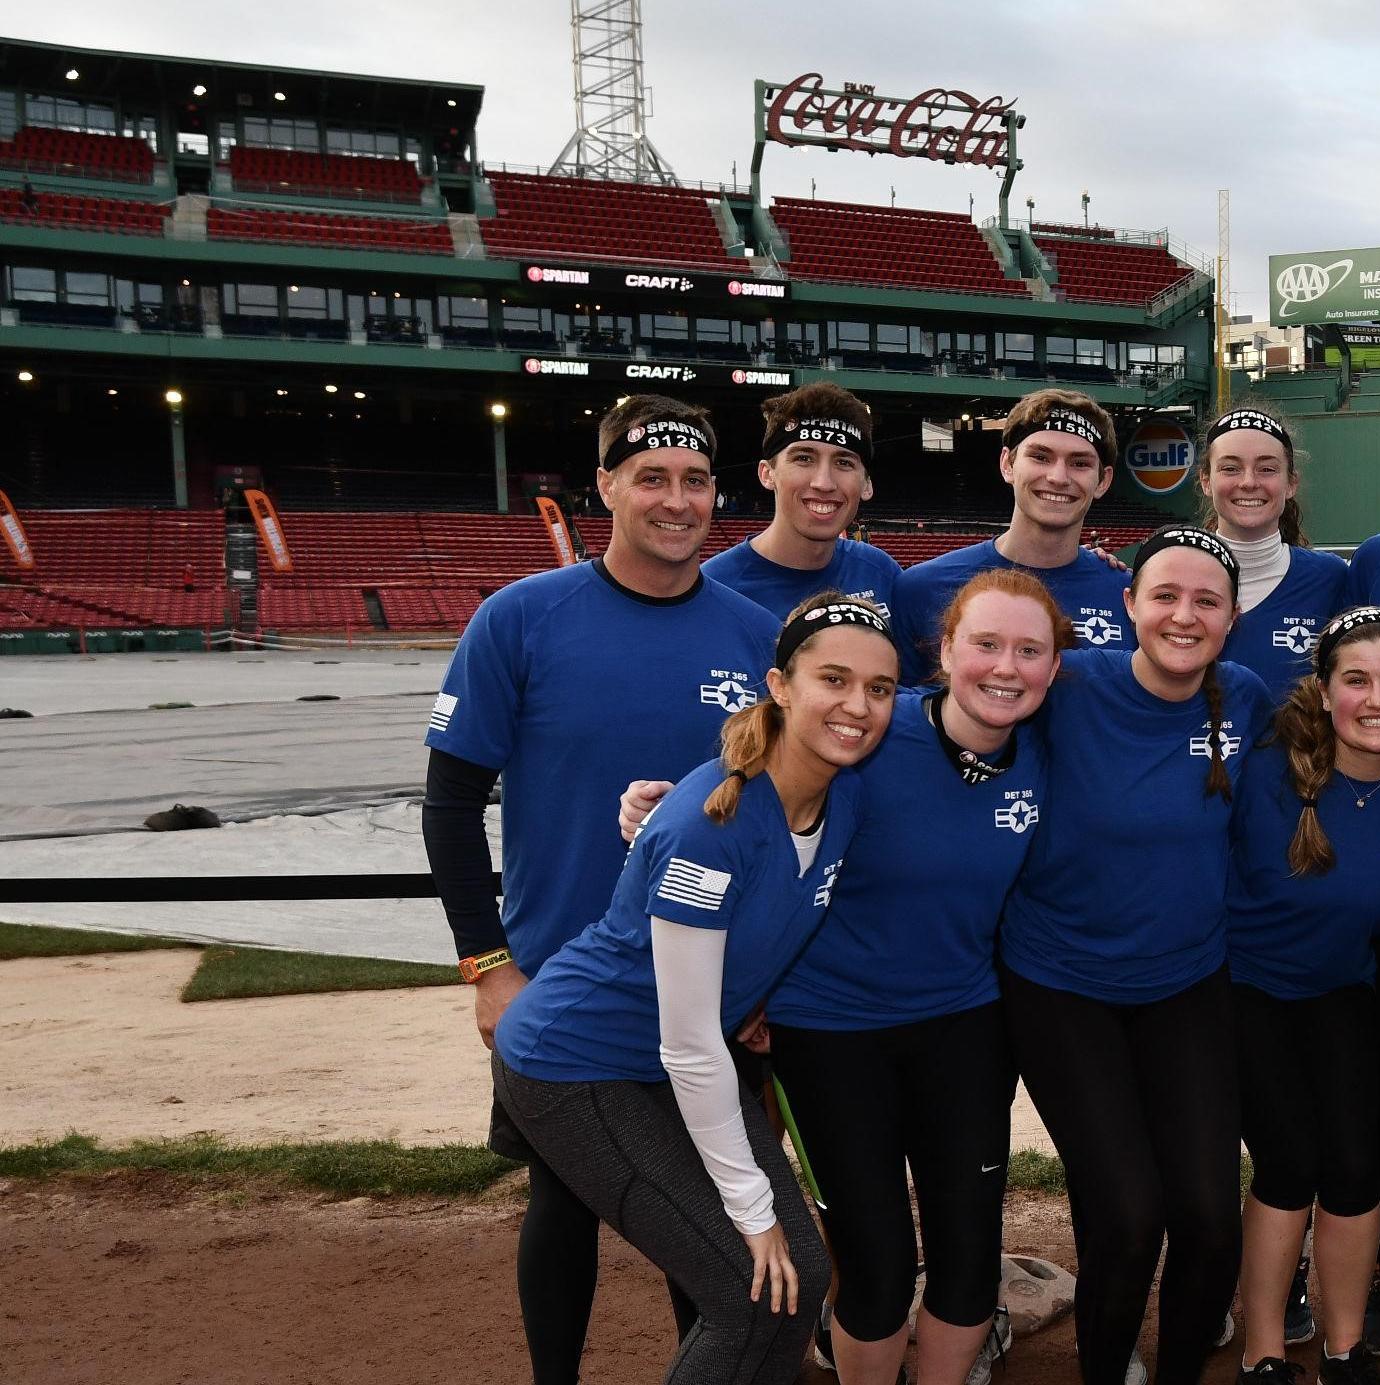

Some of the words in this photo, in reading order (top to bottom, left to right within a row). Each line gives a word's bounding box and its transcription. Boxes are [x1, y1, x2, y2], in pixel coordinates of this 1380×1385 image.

[845, 82, 875, 96] ENJOY
[543, 268, 590, 284] SPARTAN
[625, 274, 679, 290] CRAFT
[1284, 265, 1323, 300] AAA
[741, 283, 785, 298] SPARTAN
[1325, 311, 1343, 319] Auto
[1345, 309, 1380, 318] Insurance
[540, 360, 589, 375] SPARTAN
[626, 365, 682, 380] CRAFT
[745, 370, 790, 385] SPARTAN
[1051, 408, 1102, 440] SPARTAN
[1229, 418, 1273, 433] 8542
[1232, 411, 1283, 434] SPARTAN
[646, 421, 709, 447] SPARTAN
[799, 428, 847, 445] 8673
[1043, 420, 1094, 443] 11589
[647, 434, 699, 451] 9128
[1127, 442, 1189, 467] Gulf
[827, 604, 892, 633] SPARTAN
[1080, 607, 1097, 615] DET
[1099, 609, 1113, 617] 365
[1283, 617, 1301, 625] DET
[1302, 618, 1316, 626] 365
[711, 669, 730, 678] DET
[732, 671, 748, 681] 365
[1004, 791, 1020, 800] DET
[1022, 789, 1033, 799] 365
